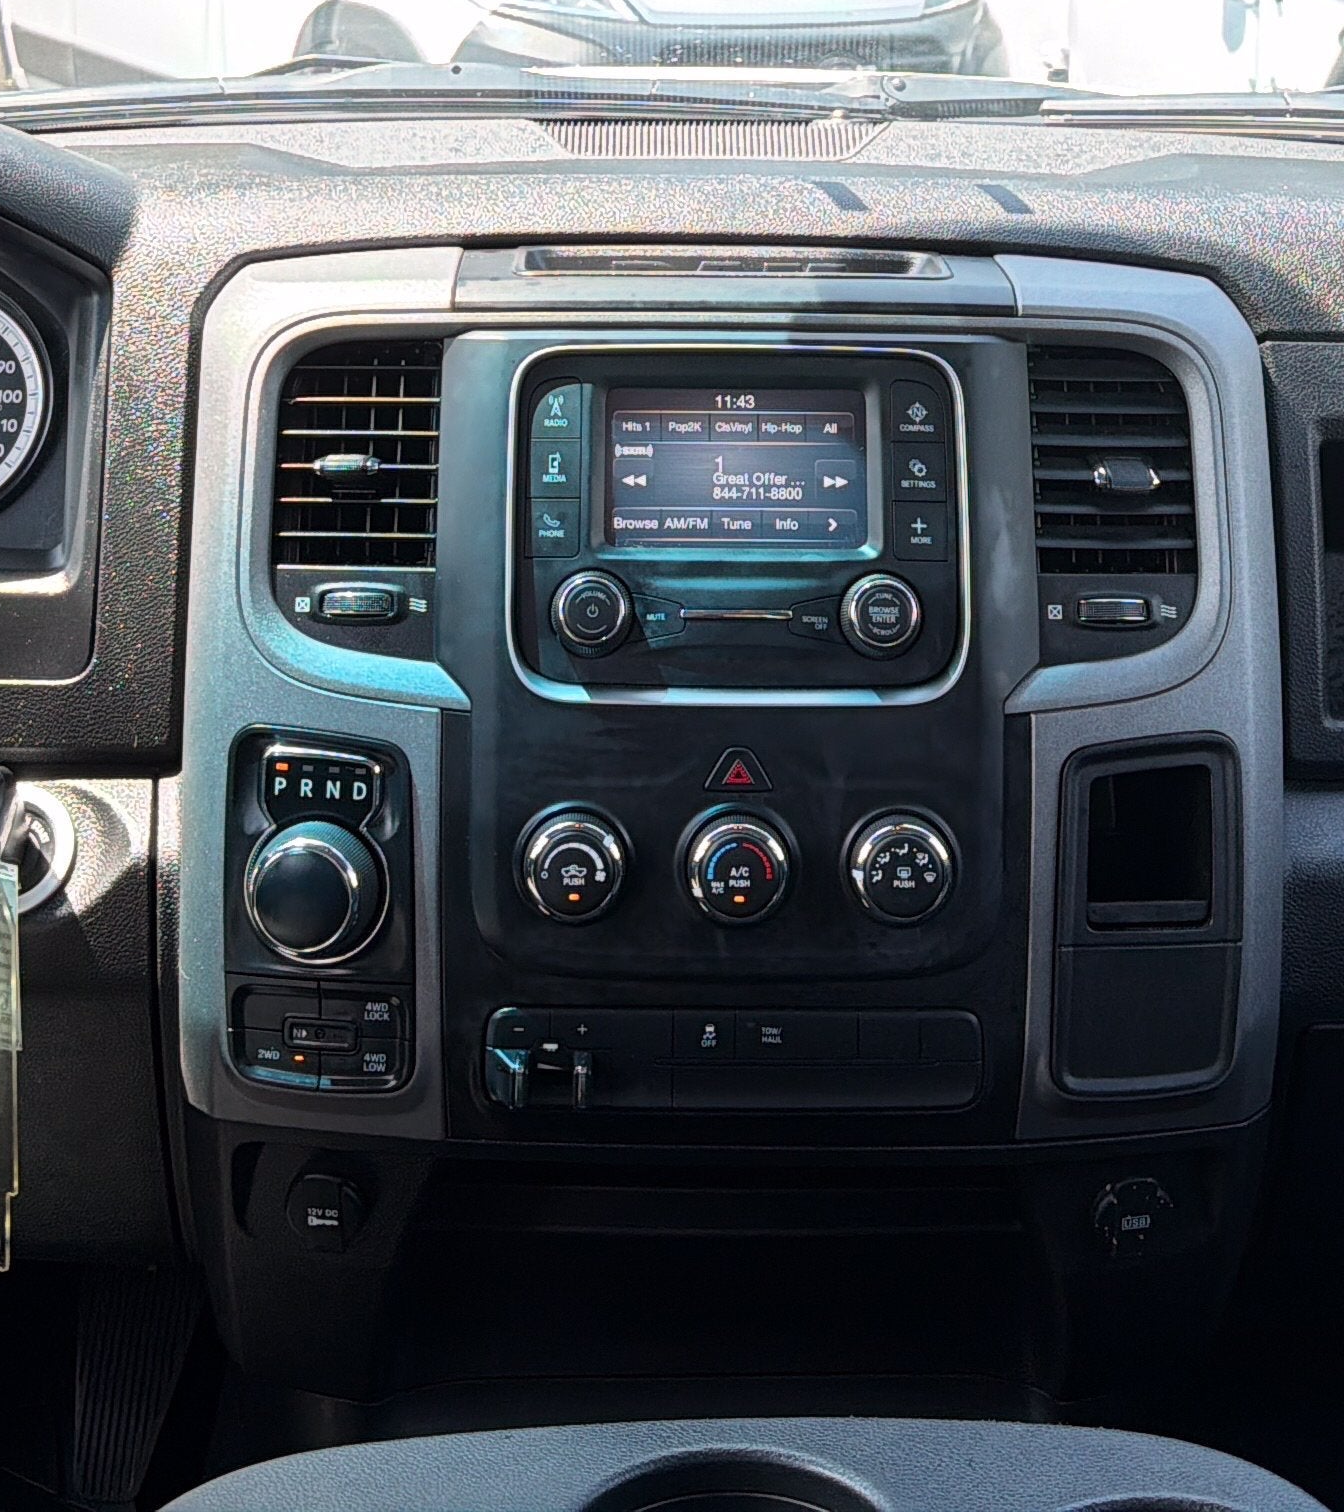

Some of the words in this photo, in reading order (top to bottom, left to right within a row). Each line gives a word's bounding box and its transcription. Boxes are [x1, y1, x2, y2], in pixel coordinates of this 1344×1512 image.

[715, 395, 755, 409] 11:43
[544, 418, 569, 427] RADIO
[622, 421, 643, 432] Hits
[645, 421, 651, 432] 1
[669, 421, 702, 433] Pop2K
[761, 422, 803, 434] Hip-Hop
[823, 422, 838, 434] All
[899, 423, 935, 433] COMPASS
[714, 455, 723, 473] 1
[542, 474, 567, 483] MEDIA
[713, 473, 749, 486] Great
[752, 473, 788, 486] Offer
[901, 479, 936, 489] SETTINGS
[712, 488, 803, 500] 844-711-8800
[613, 517, 659, 529] Browse
[664, 518, 709, 529] AM/FM
[721, 518, 752, 530] Tune
[775, 518, 799, 531] Info
[539, 529, 565, 538] PHONE
[910, 536, 933, 545] MORE
[581, 590, 607, 599] VOLUME
[868, 606, 900, 614] BROWSE
[646, 612, 666, 621] MUTE
[802, 615, 828, 623] SCREEN
[872, 615, 896, 624] ENTER
[274, 776, 287, 796] P
[300, 778, 313, 798] R
[326, 779, 341, 800] N
[352, 781, 367, 801] D
[730, 866, 750, 877] A/C
[563, 878, 585, 886] PUSH
[729, 879, 751, 888] PUSH
[893, 879, 916, 888] PUSH
[365, 1002, 389, 1012] 4WD
[363, 1011, 390, 1022] LOCK
[700, 1039, 718, 1048] OFF
[761, 1035, 782, 1044] HAUL
[257, 1048, 280, 1060] 2WD
[363, 1053, 387, 1063] 4WD
[363, 1062, 387, 1073] LOW
[307, 1207, 323, 1216] 12V
[325, 1209, 339, 1218] DC
[1124, 1216, 1146, 1229] USB
